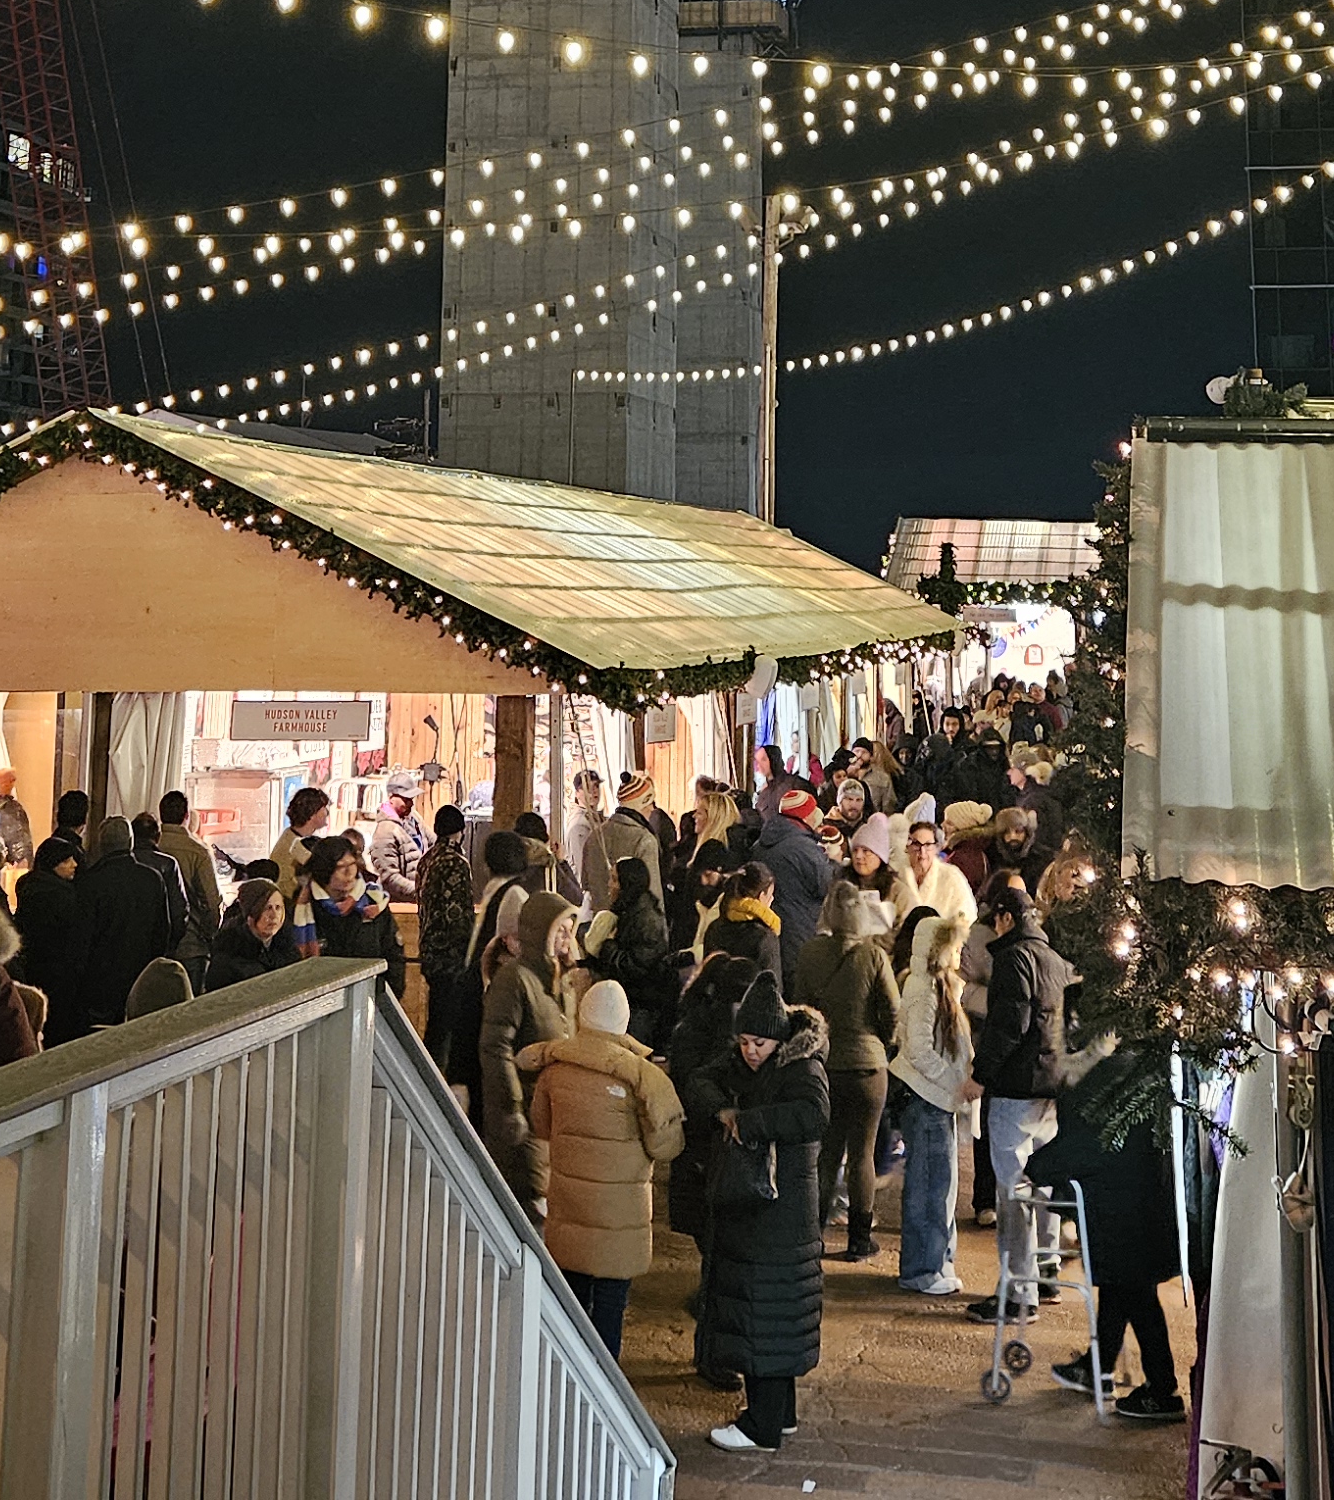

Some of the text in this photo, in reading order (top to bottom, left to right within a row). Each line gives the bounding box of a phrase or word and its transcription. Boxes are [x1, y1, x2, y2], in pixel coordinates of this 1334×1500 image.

[265, 709, 338, 720] HUDSON VALLEY
[273, 722, 327, 733] FARMHOUSE
